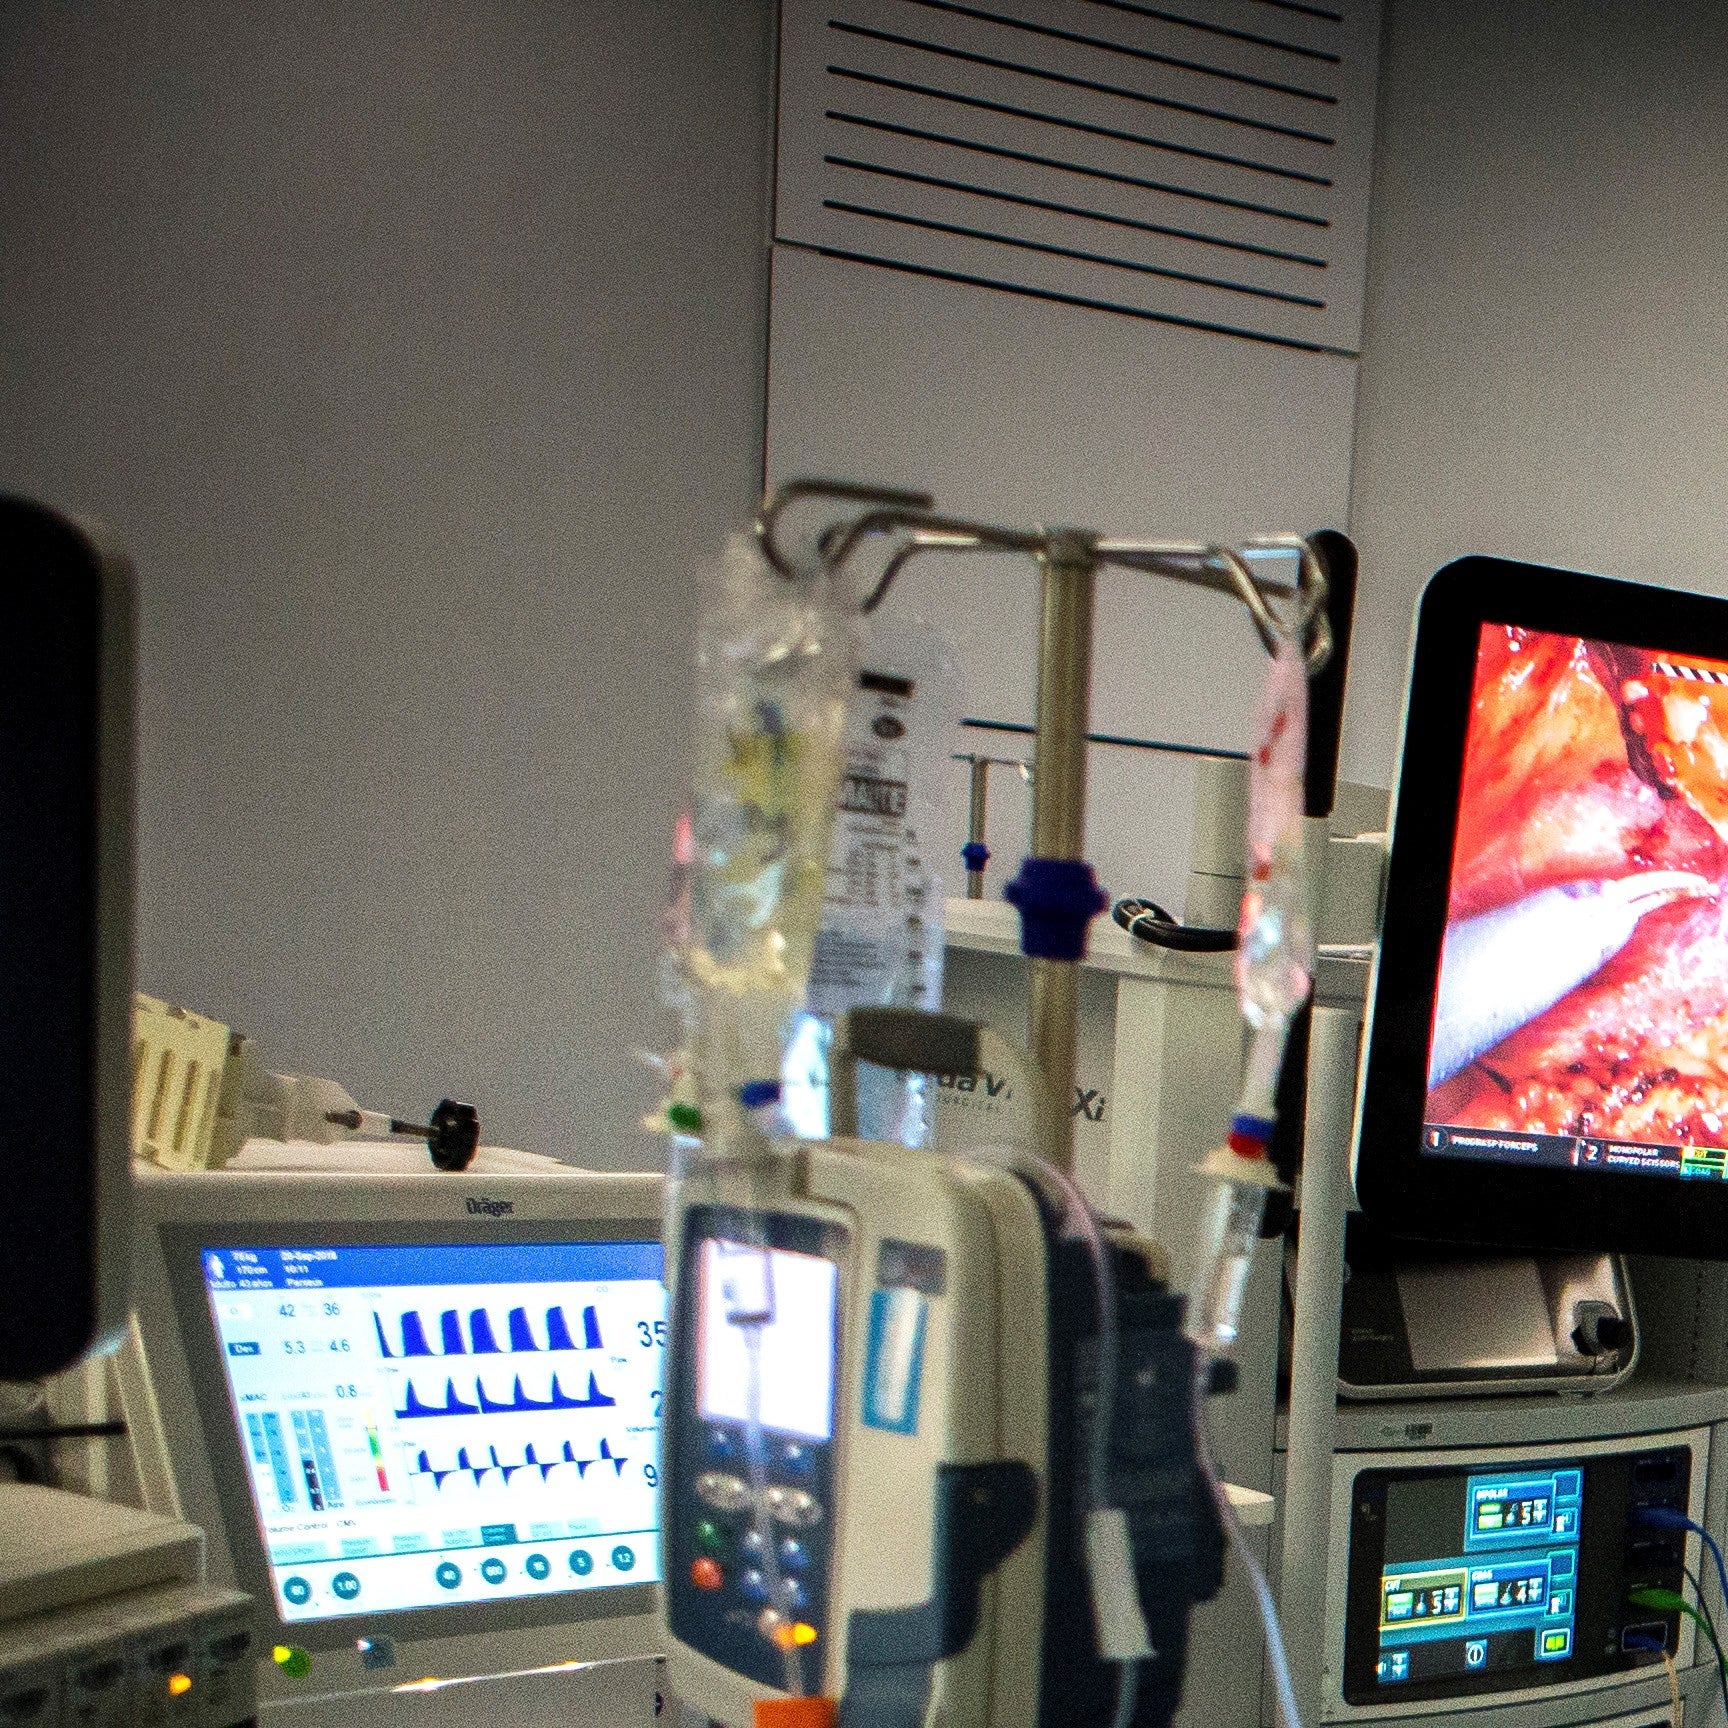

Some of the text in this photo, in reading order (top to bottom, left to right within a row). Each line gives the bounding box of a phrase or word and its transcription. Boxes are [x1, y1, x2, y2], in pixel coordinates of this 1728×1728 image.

[1069, 1086, 1105, 1122] Xi
[1431, 1130, 1440, 1147] 1
[1587, 1145, 1599, 1161] 2
[465, 1197, 515, 1218] Dräger
[278, 1303, 296, 1318] 42
[323, 1301, 341, 1316] 36
[283, 1340, 306, 1355] 5.3
